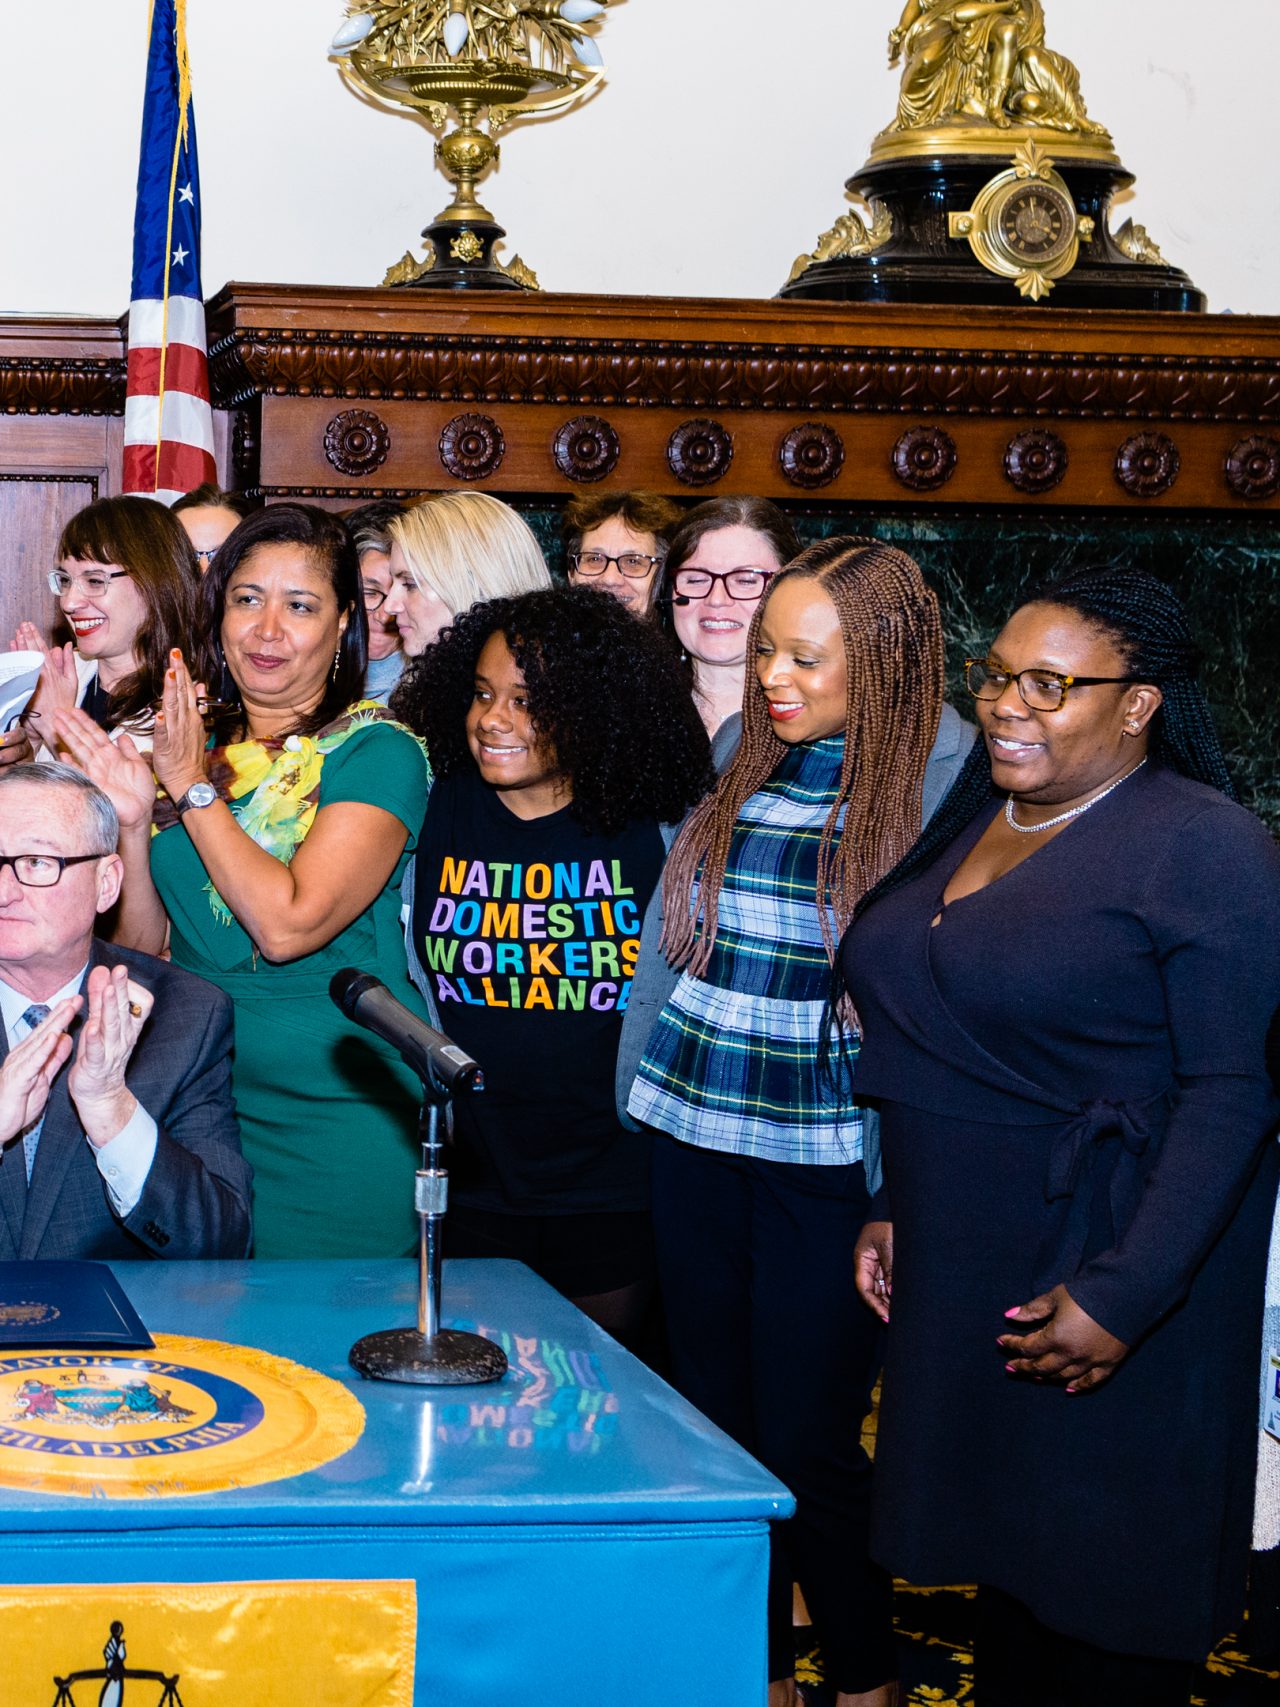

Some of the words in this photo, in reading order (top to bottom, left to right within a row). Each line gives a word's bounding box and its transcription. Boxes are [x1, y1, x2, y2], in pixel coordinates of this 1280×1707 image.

[439, 856, 634, 900] NATIONAL
[429, 897, 641, 939] DOMESTIC
[425, 935, 641, 978] WORKERS
[132, 1359, 185, 1375] OF
